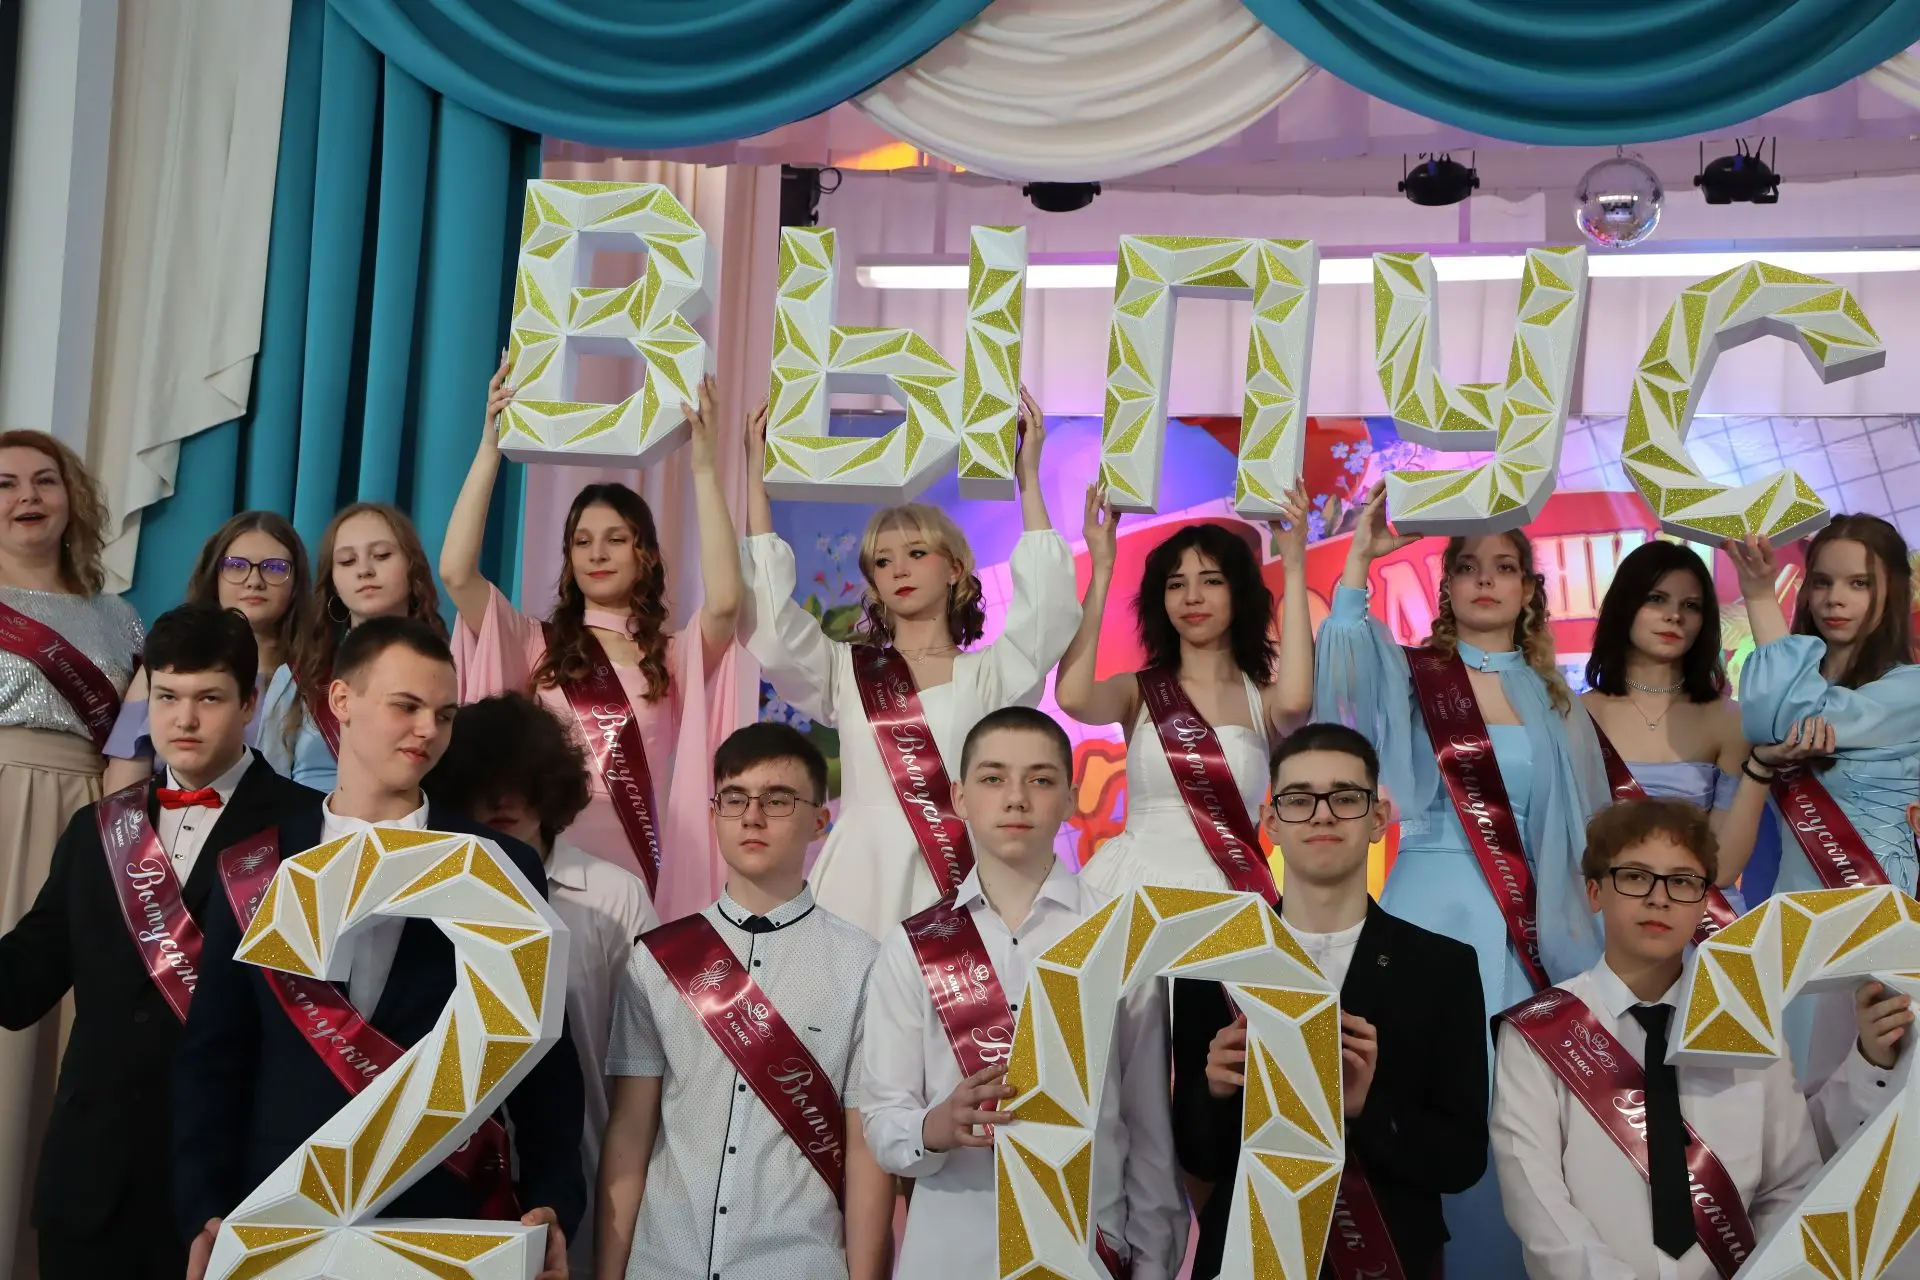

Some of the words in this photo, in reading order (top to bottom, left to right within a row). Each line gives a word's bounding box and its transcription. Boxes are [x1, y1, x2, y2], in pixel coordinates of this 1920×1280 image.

[944, 964, 955, 973] 9
[946, 974, 965, 1004] класс
[723, 1011, 734, 1020] 9
[729, 1019, 752, 1047] класс
[1560, 1039, 1573, 1049] 9
[1567, 1048, 1595, 1078] класс
